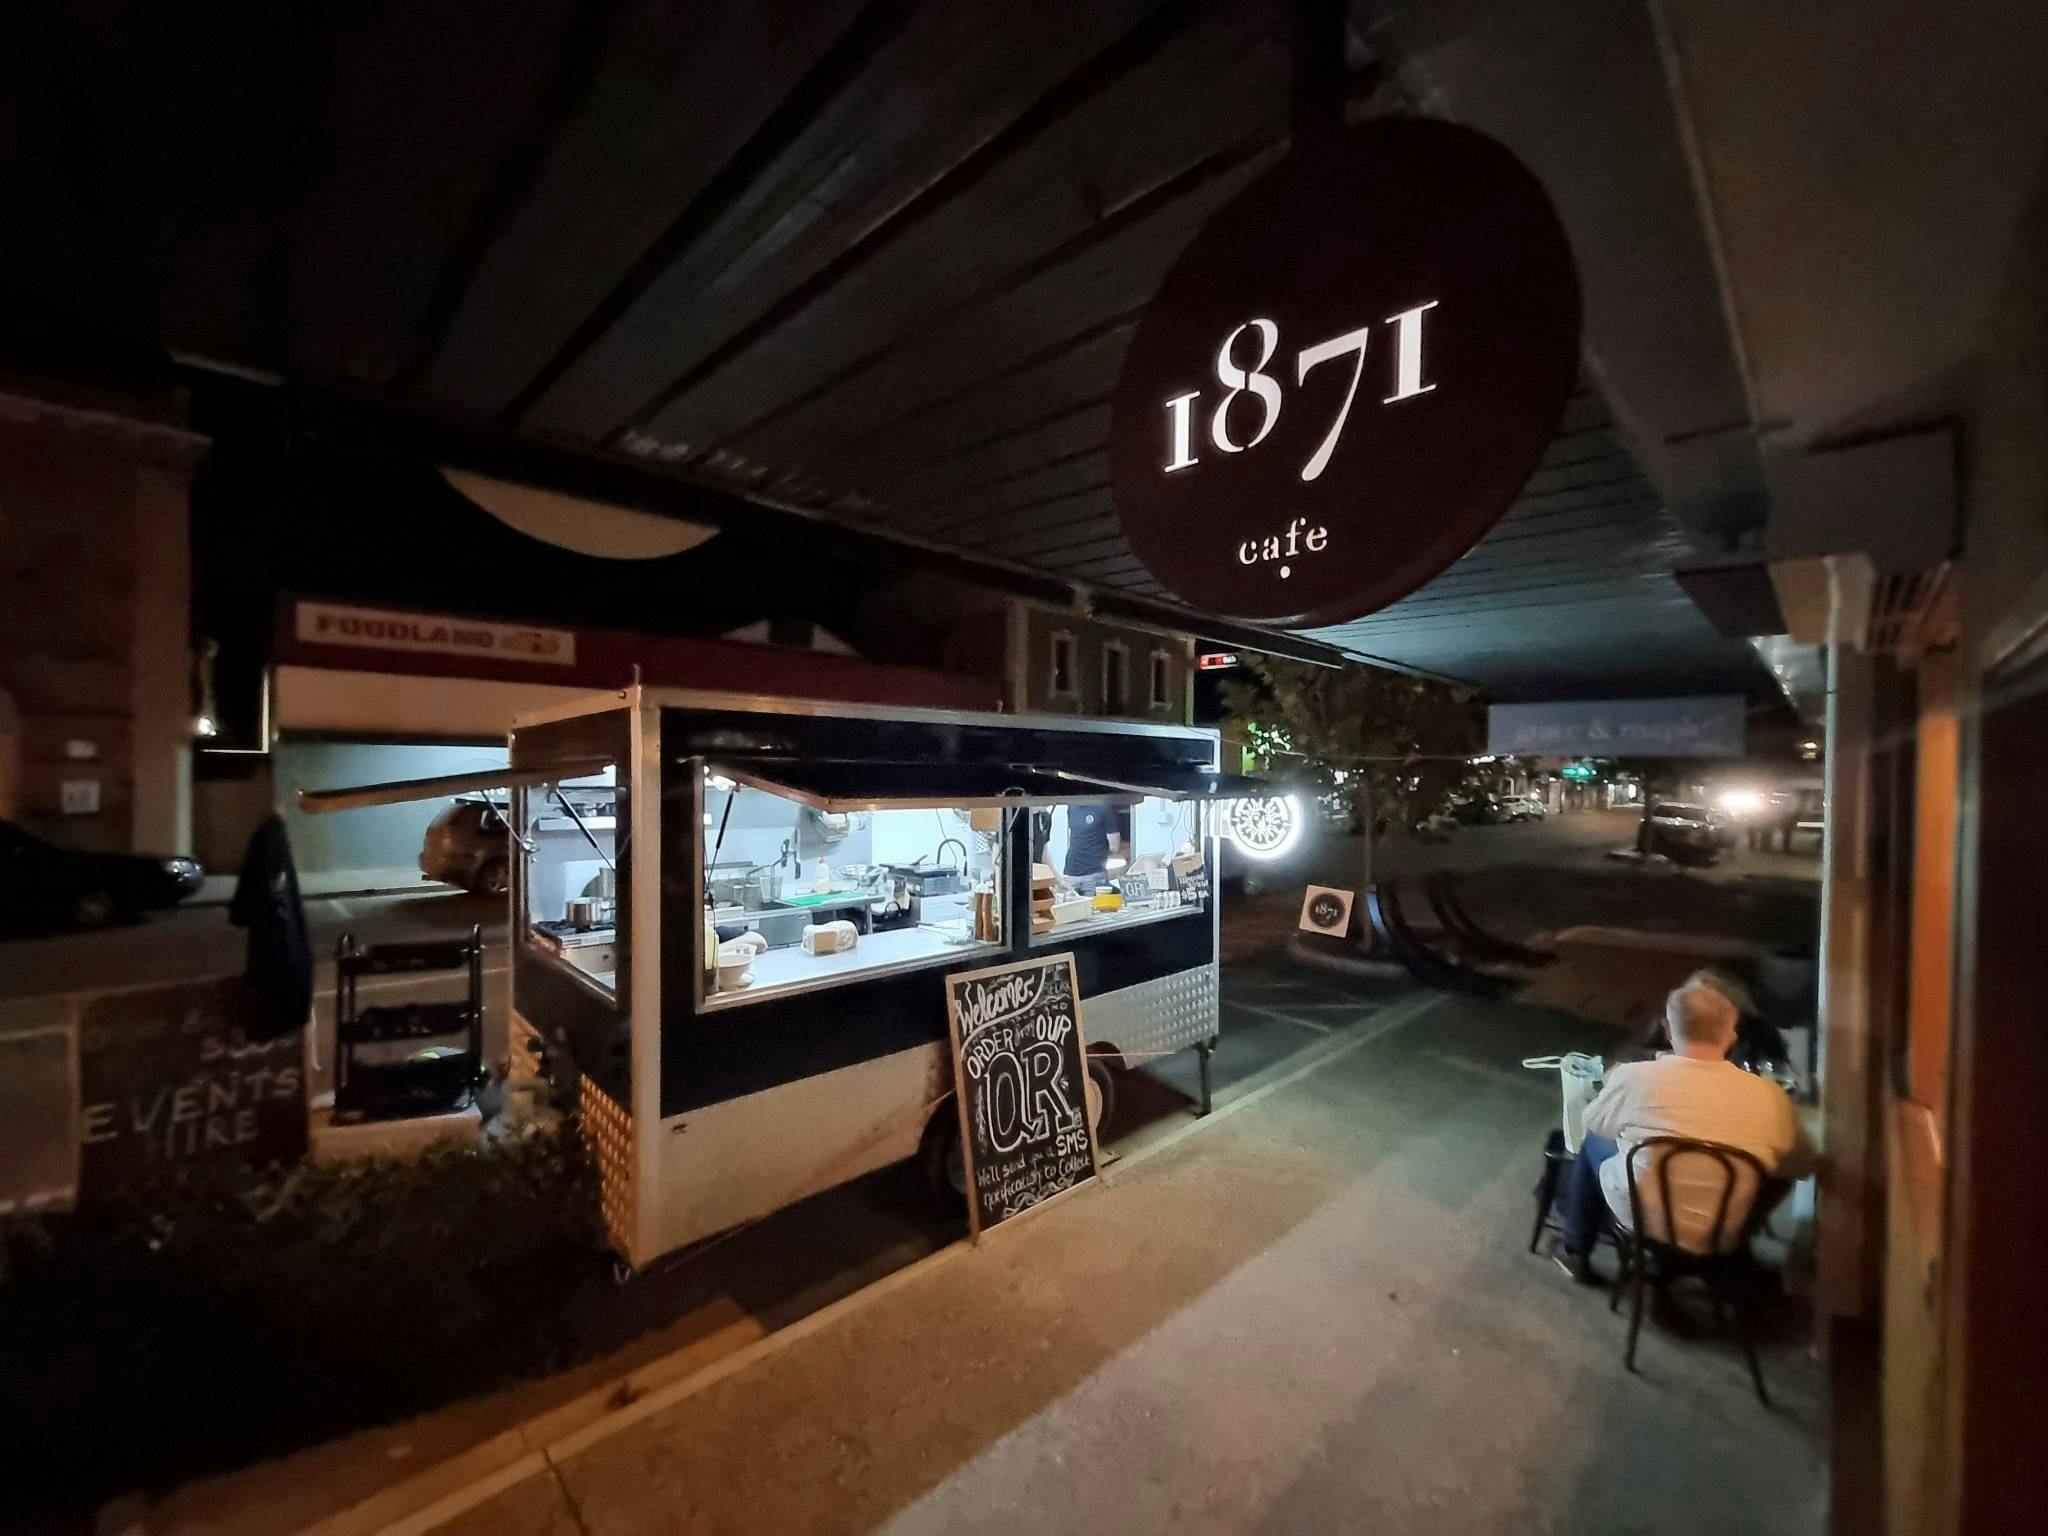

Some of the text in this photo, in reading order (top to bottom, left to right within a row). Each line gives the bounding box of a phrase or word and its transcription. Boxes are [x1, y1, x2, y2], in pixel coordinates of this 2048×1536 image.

[1164, 300, 1440, 482] 1871
[1238, 517, 1328, 565] cafe
[316, 614, 496, 648] FOODLAND
[967, 1028, 1016, 1079] ORDER
[1036, 1014, 1072, 1046] OUR
[1002, 1153, 1026, 1178] send
[1056, 1129, 1088, 1156] SMS
[1044, 1165, 1058, 1179] to
